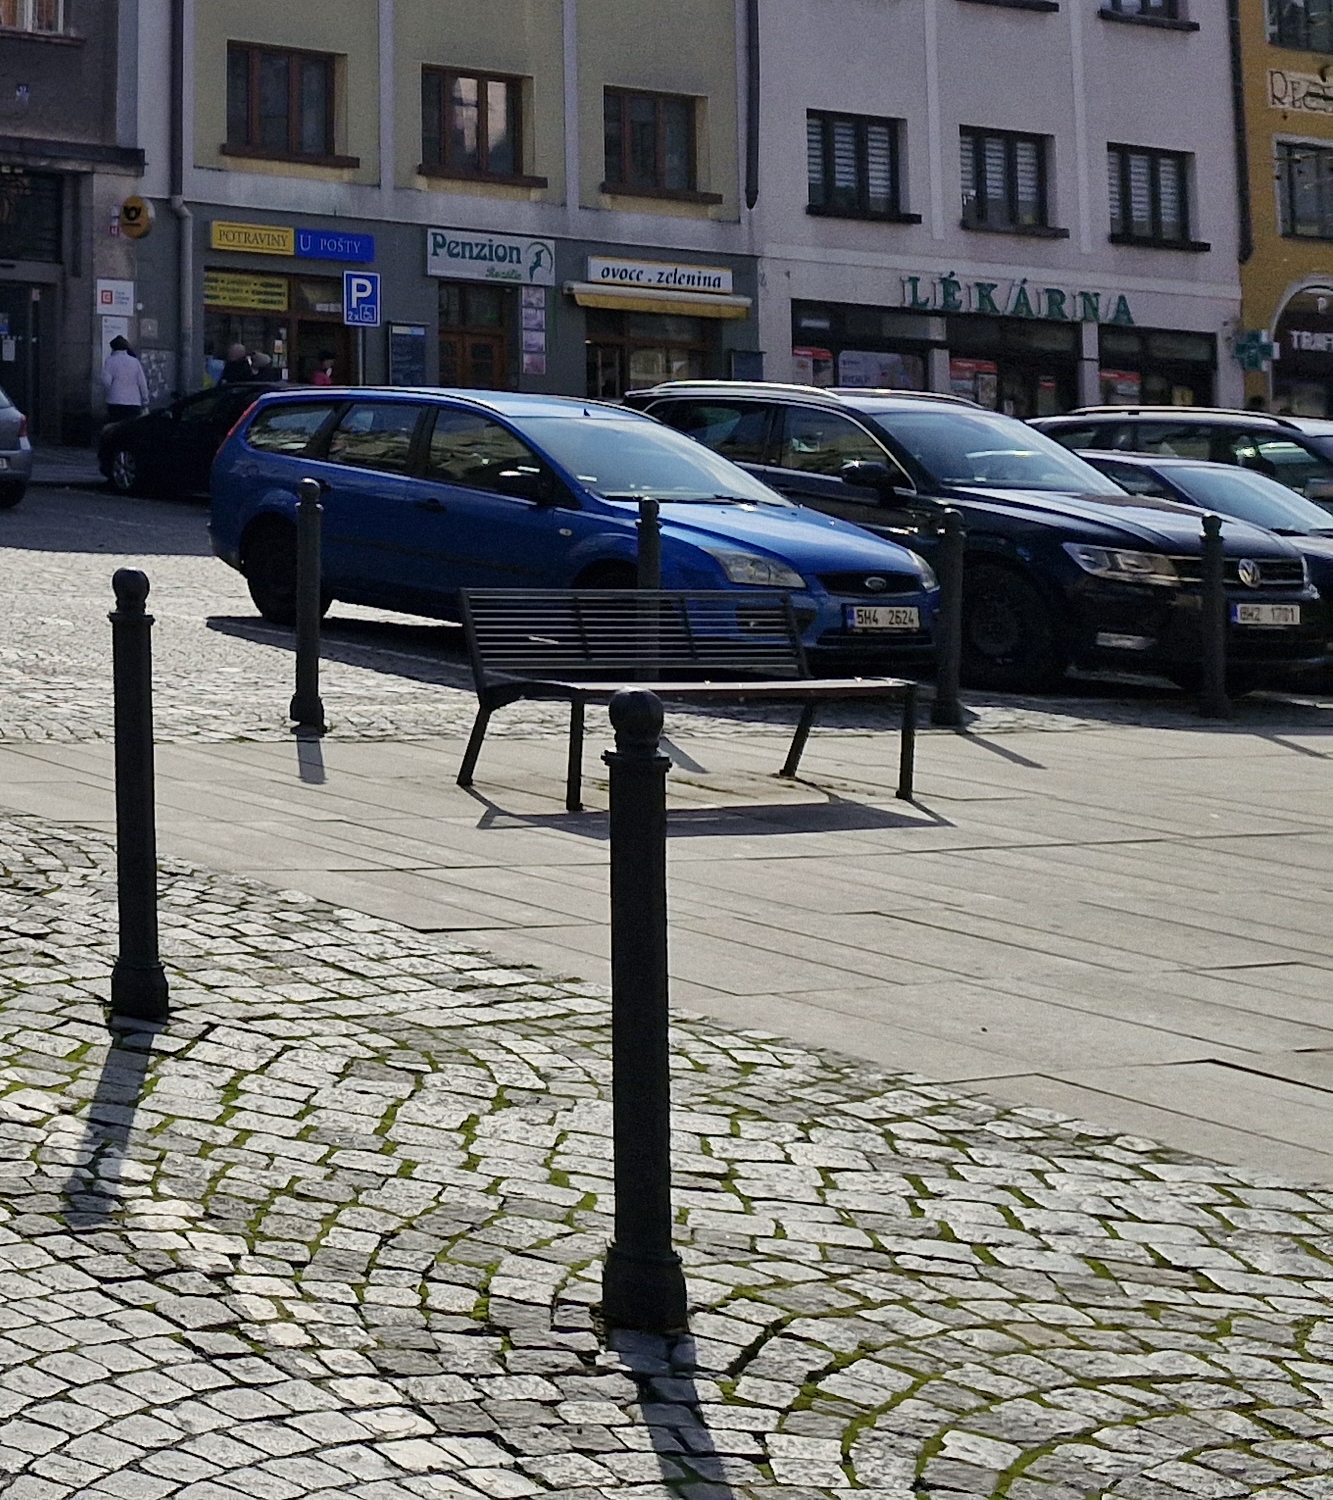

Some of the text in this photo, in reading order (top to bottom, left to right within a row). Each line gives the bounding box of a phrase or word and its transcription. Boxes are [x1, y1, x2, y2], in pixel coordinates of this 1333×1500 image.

[218, 229, 361, 254] POTRAVINY U POŠTY
[431, 232, 522, 264] Penzion
[601, 266, 644, 281] ovoce
[656, 267, 722, 288] zelenina
[351, 278, 372, 309] P
[905, 271, 1135, 324] LÉKÁRNA
[856, 609, 878, 625] 5H4
